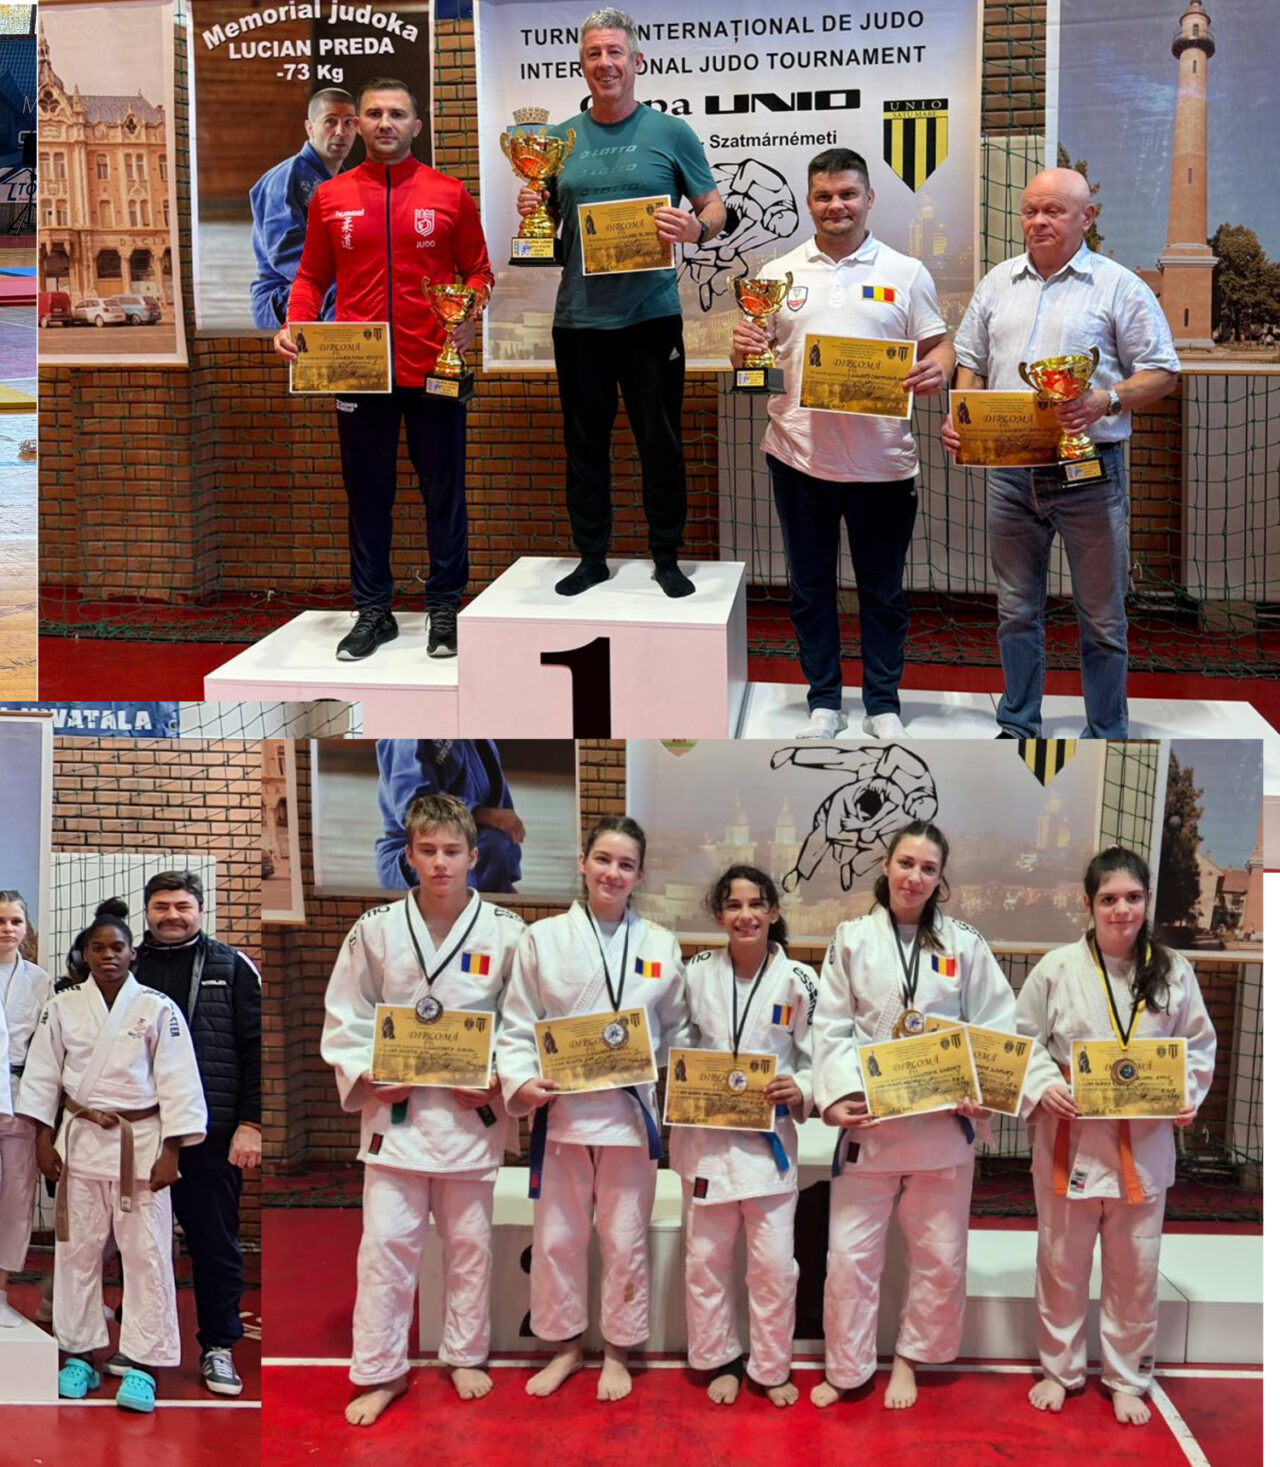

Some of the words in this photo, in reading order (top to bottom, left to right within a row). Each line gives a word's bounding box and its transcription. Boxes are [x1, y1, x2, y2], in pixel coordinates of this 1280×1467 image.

[201, 0, 321, 50] Memorial
[328, 0, 419, 42] judoka
[521, 27, 580, 46] TURN
[639, 16, 814, 44] NTERNAȚIONAL
[822, 14, 852, 33] DE
[860, 10, 924, 31] JUDO
[228, 39, 312, 60] LUCIAN
[319, 37, 395, 56] PREDA
[699, 52, 759, 74] JUDO
[770, 46, 927, 69] TOURNAMENT
[276, 64, 310, 81] -73
[317, 65, 344, 83] Kg
[704, 89, 861, 115] UNIO
[890, 100, 942, 111] UNIO
[709, 130, 838, 149] Szatmárnémeti
[416, 240, 436, 249] JUDO
[540, 637, 611, 739] 1
